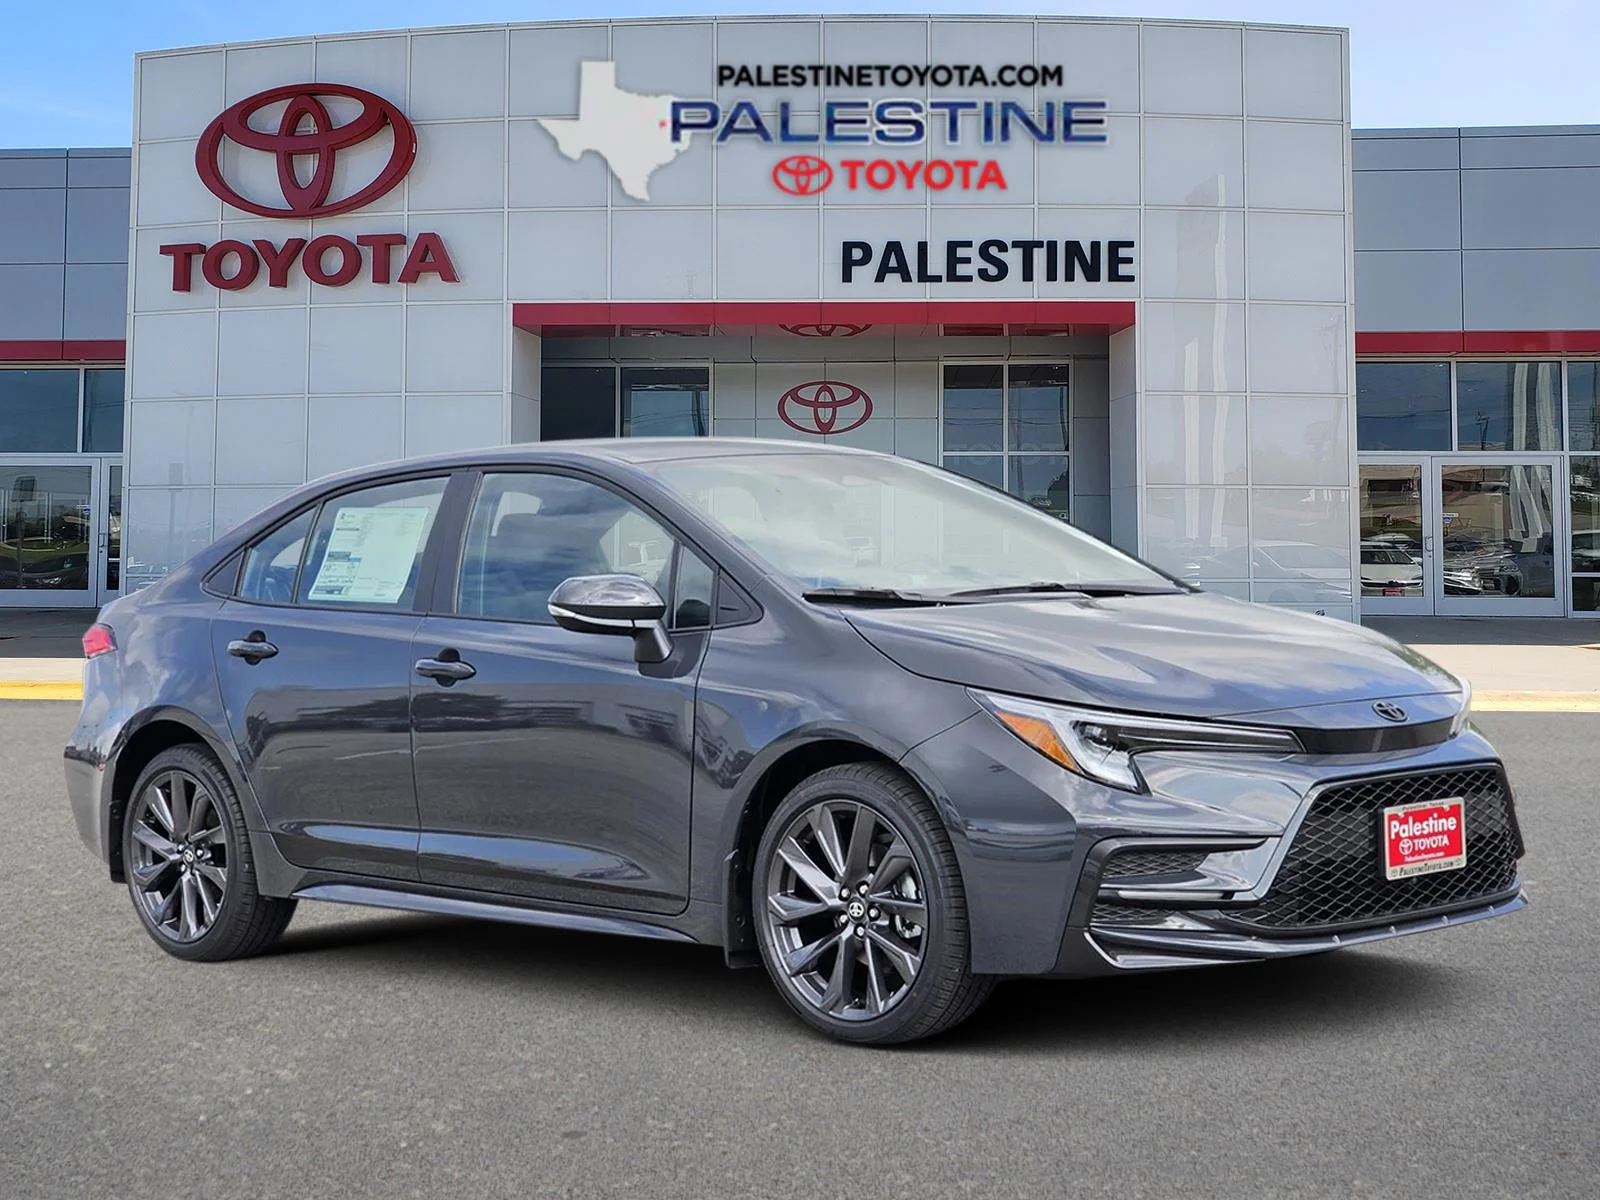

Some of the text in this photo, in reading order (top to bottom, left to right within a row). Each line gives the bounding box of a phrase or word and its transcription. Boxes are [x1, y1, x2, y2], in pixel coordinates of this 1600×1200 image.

[159, 232, 459, 293] TOYOTA
[842, 241, 1134, 283] PALESTINE
[1390, 813, 1457, 839] Palestine
[1413, 835, 1449, 851] TOYOTA
